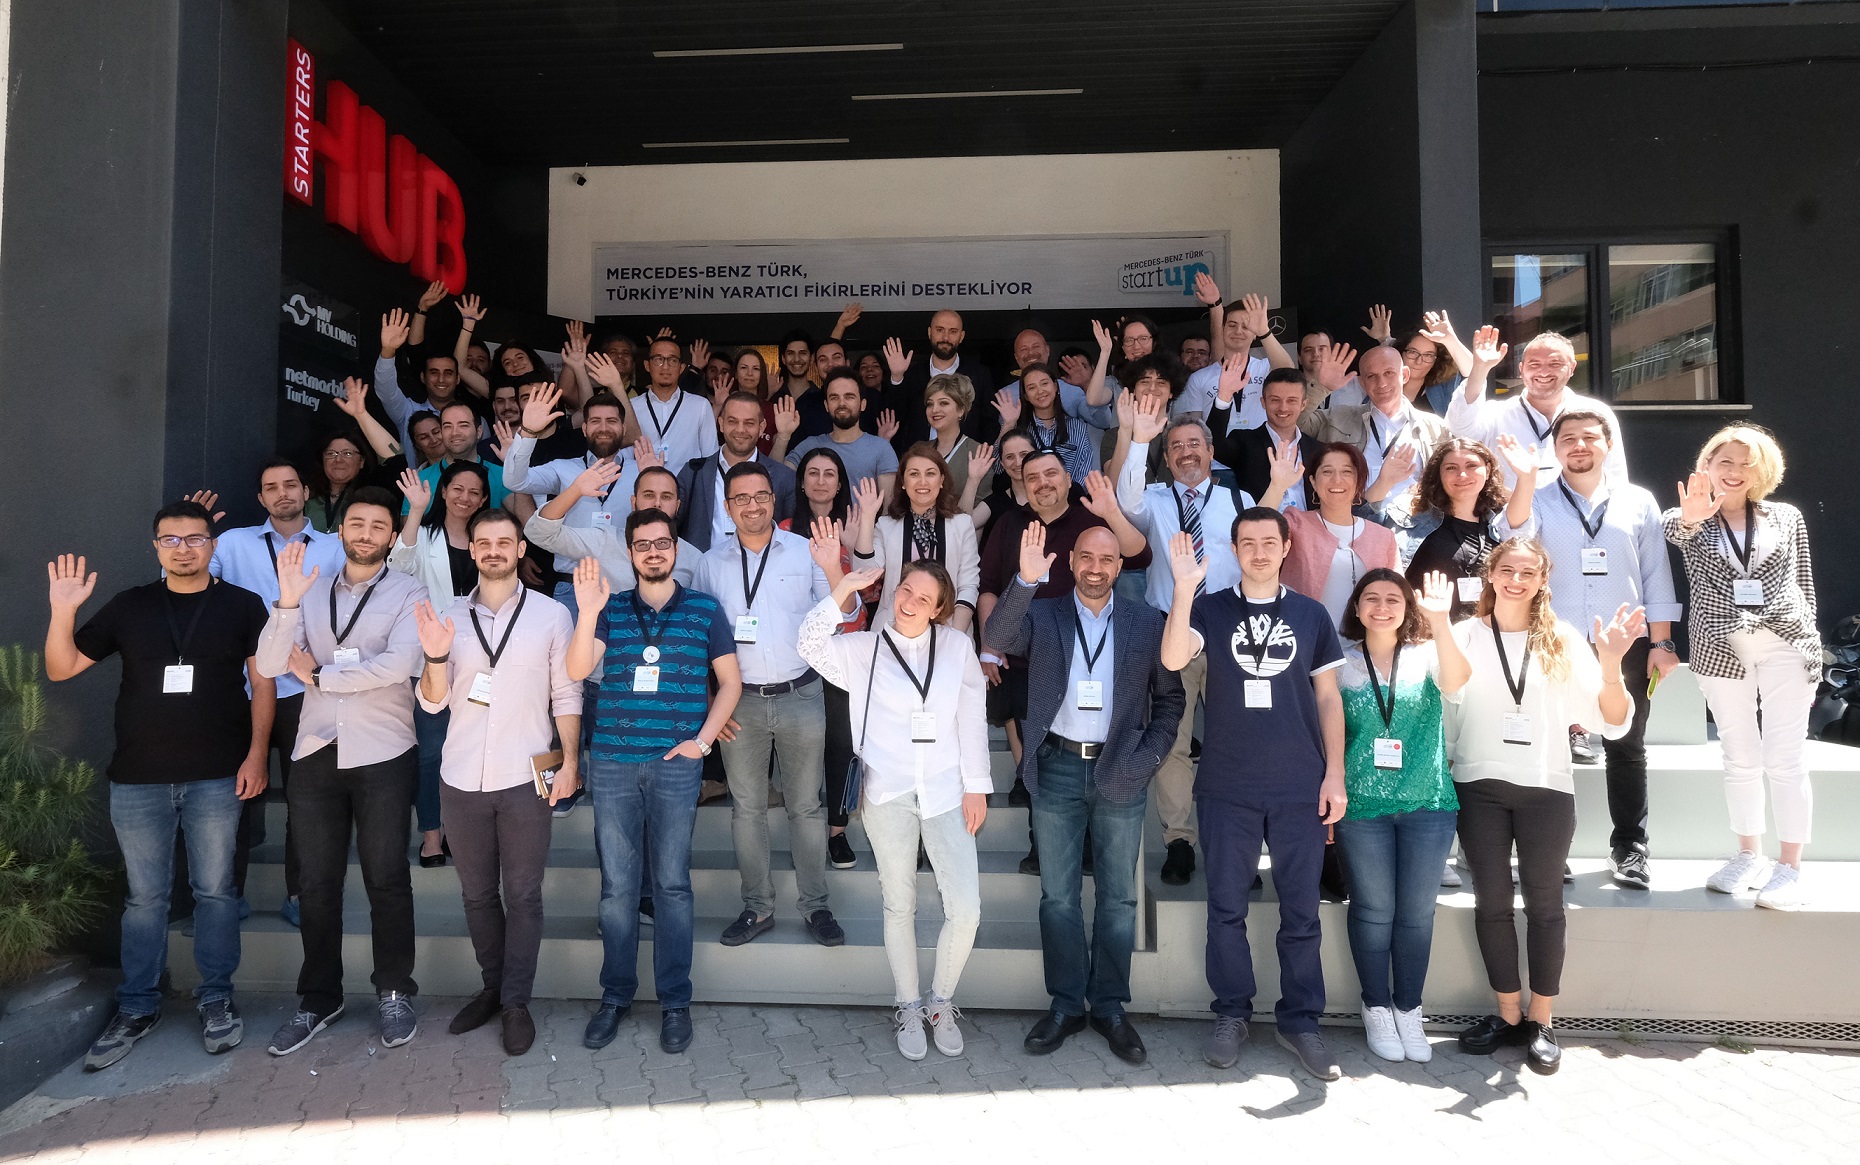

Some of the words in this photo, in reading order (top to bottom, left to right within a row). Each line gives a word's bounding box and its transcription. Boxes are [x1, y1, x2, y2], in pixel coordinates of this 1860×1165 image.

[293, 48, 311, 197] STARTERS
[284, 39, 467, 296] HUB
[606, 266, 752, 280] MERCEDES-BENZ
[757, 262, 807, 279] TÜRK,
[1124, 253, 1183, 271] MERCEDES-BENZ
[1185, 249, 1204, 260] TÜRK
[720, 285, 798, 298] YARATICI
[804, 281, 905, 297] FİKİRLERİNİ
[912, 280, 1032, 296] DESTEKLİYOR
[1122, 262, 1209, 296] startup
[317, 319, 357, 347] HOLDING
[285, 367, 348, 399] netmarbl
[1247, 376, 1265, 385] ASS
[285, 385, 320, 412] Turkey
